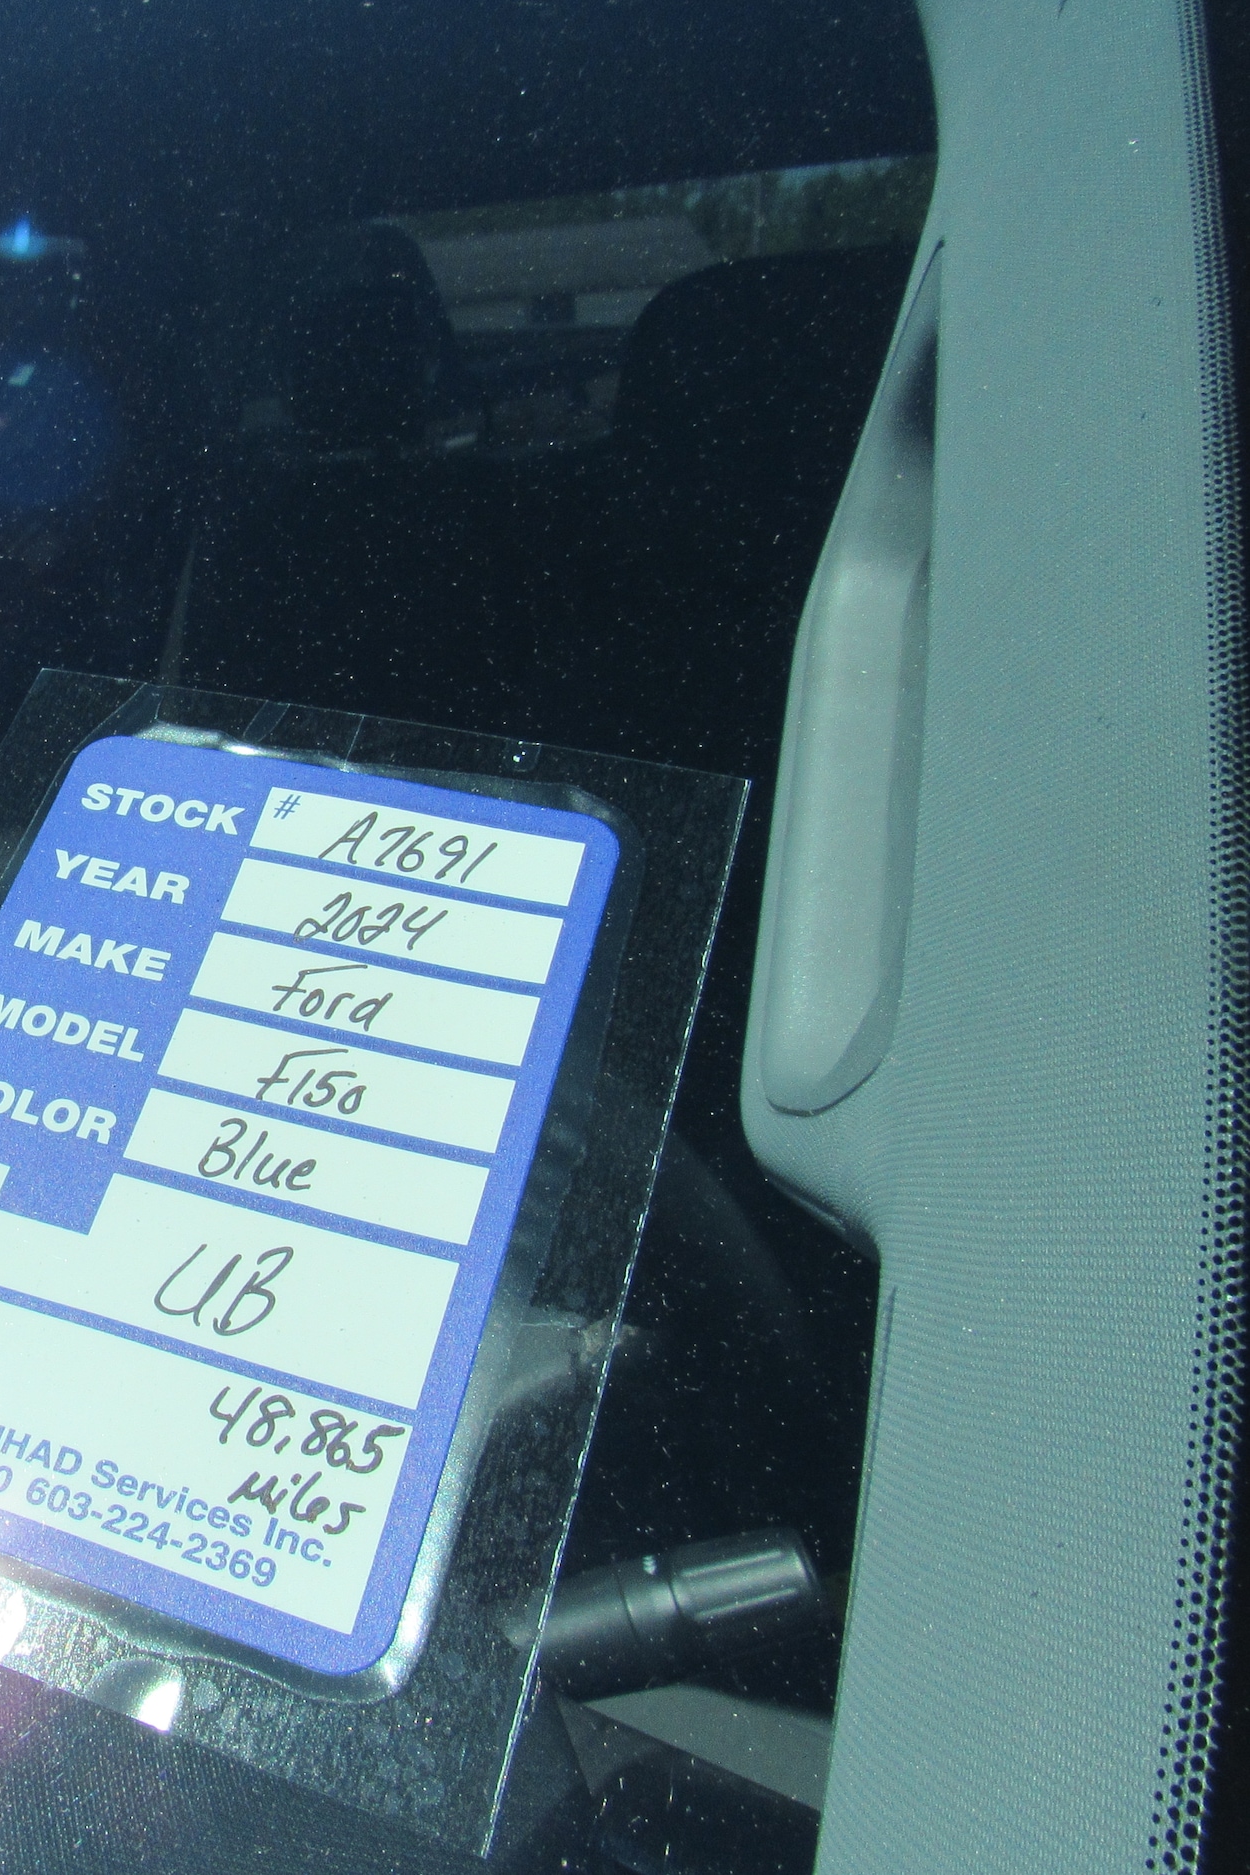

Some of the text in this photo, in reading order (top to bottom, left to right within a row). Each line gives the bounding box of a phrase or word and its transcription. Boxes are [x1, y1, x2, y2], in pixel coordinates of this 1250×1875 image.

[81, 782, 302, 836] STOCK #
[54, 849, 190, 905] YEAR
[319, 810, 498, 884] A7691
[14, 920, 172, 982] MAKE
[295, 892, 448, 951] 2024
[271, 964, 395, 1032] Ford
[255, 1048, 367, 1115] F150
[198, 1117, 318, 1191] Blue
[209, 1385, 406, 1475] 48,865
[26, 1478, 277, 1588] 603-224-2369
[90, 1459, 253, 1539] Services
[264, 1516, 333, 1567] Inc.
